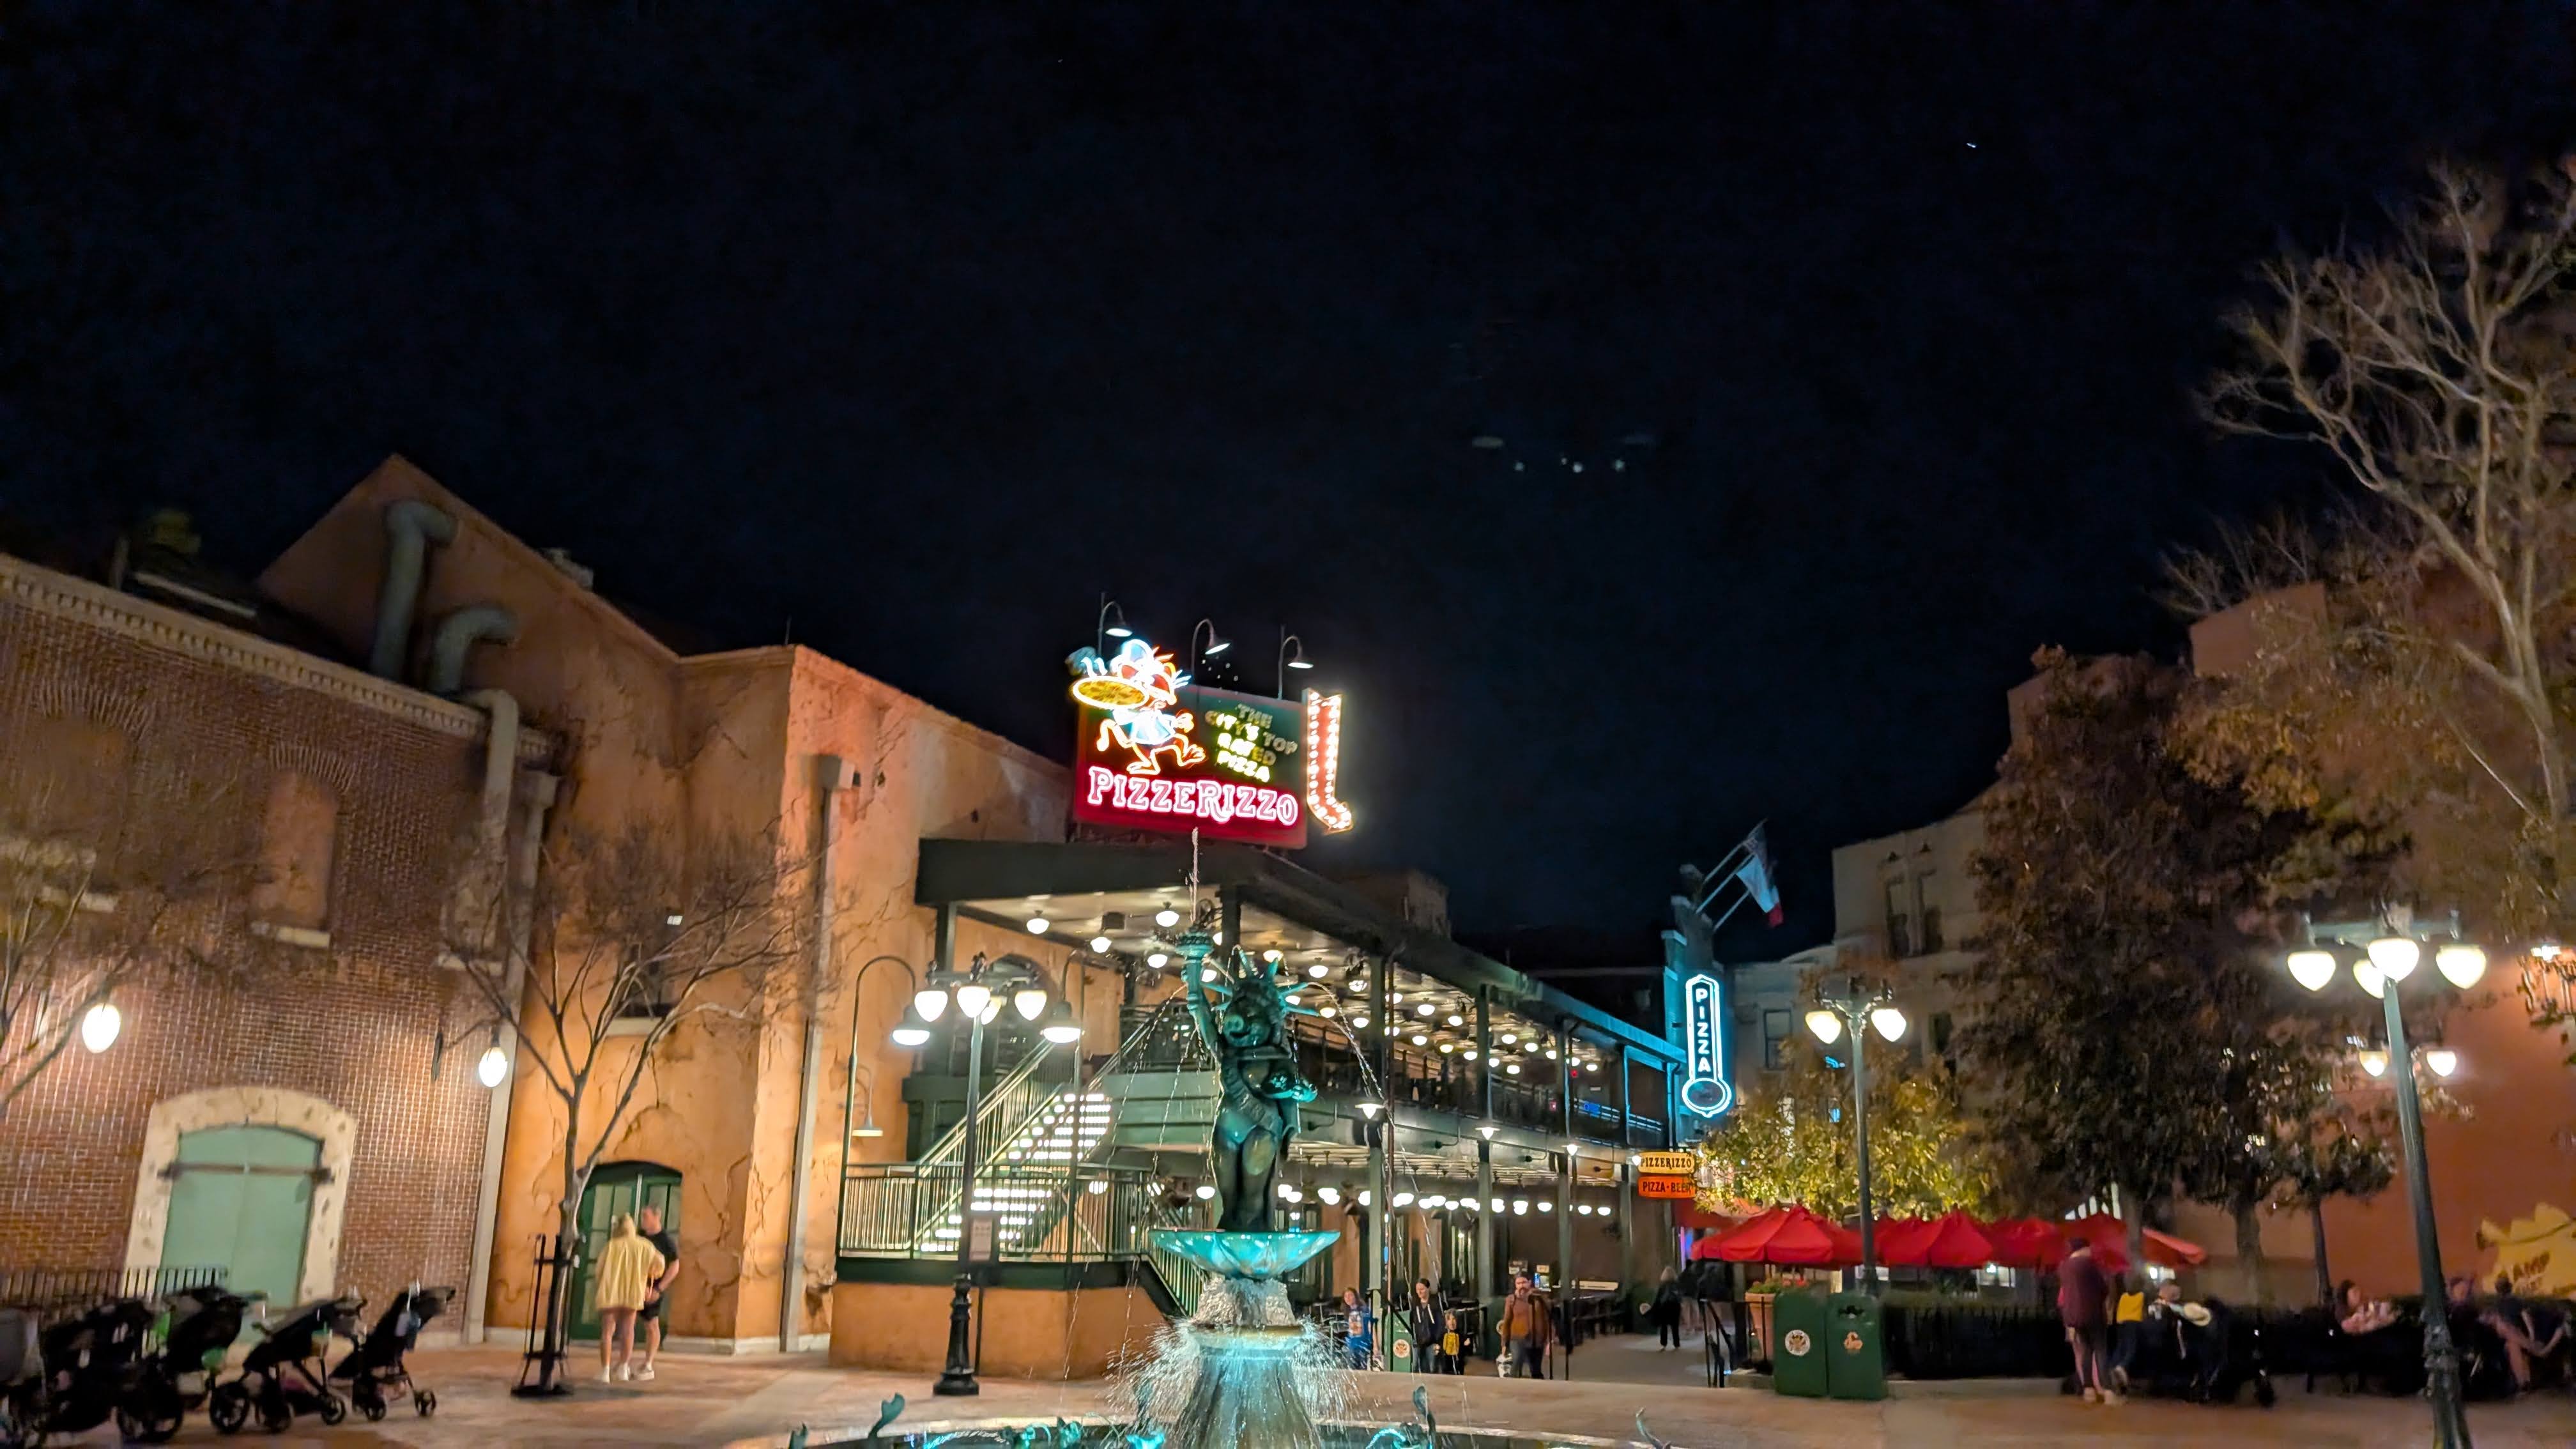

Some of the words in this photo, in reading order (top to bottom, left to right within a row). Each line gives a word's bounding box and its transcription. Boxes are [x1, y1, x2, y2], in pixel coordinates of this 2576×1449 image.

[1237, 703, 1273, 729] THE
[1262, 732, 1298, 755] TOP
[1215, 750, 1270, 783] PIZZA
[1087, 765, 1299, 826] PIZZERIZZO
[1695, 988, 1712, 1072] PIZZA
[1640, 1157, 1692, 1170] PIZZERIZZO
[1642, 1181, 1666, 1193] PIZZA
[1671, 1182, 1692, 1193] BEER
